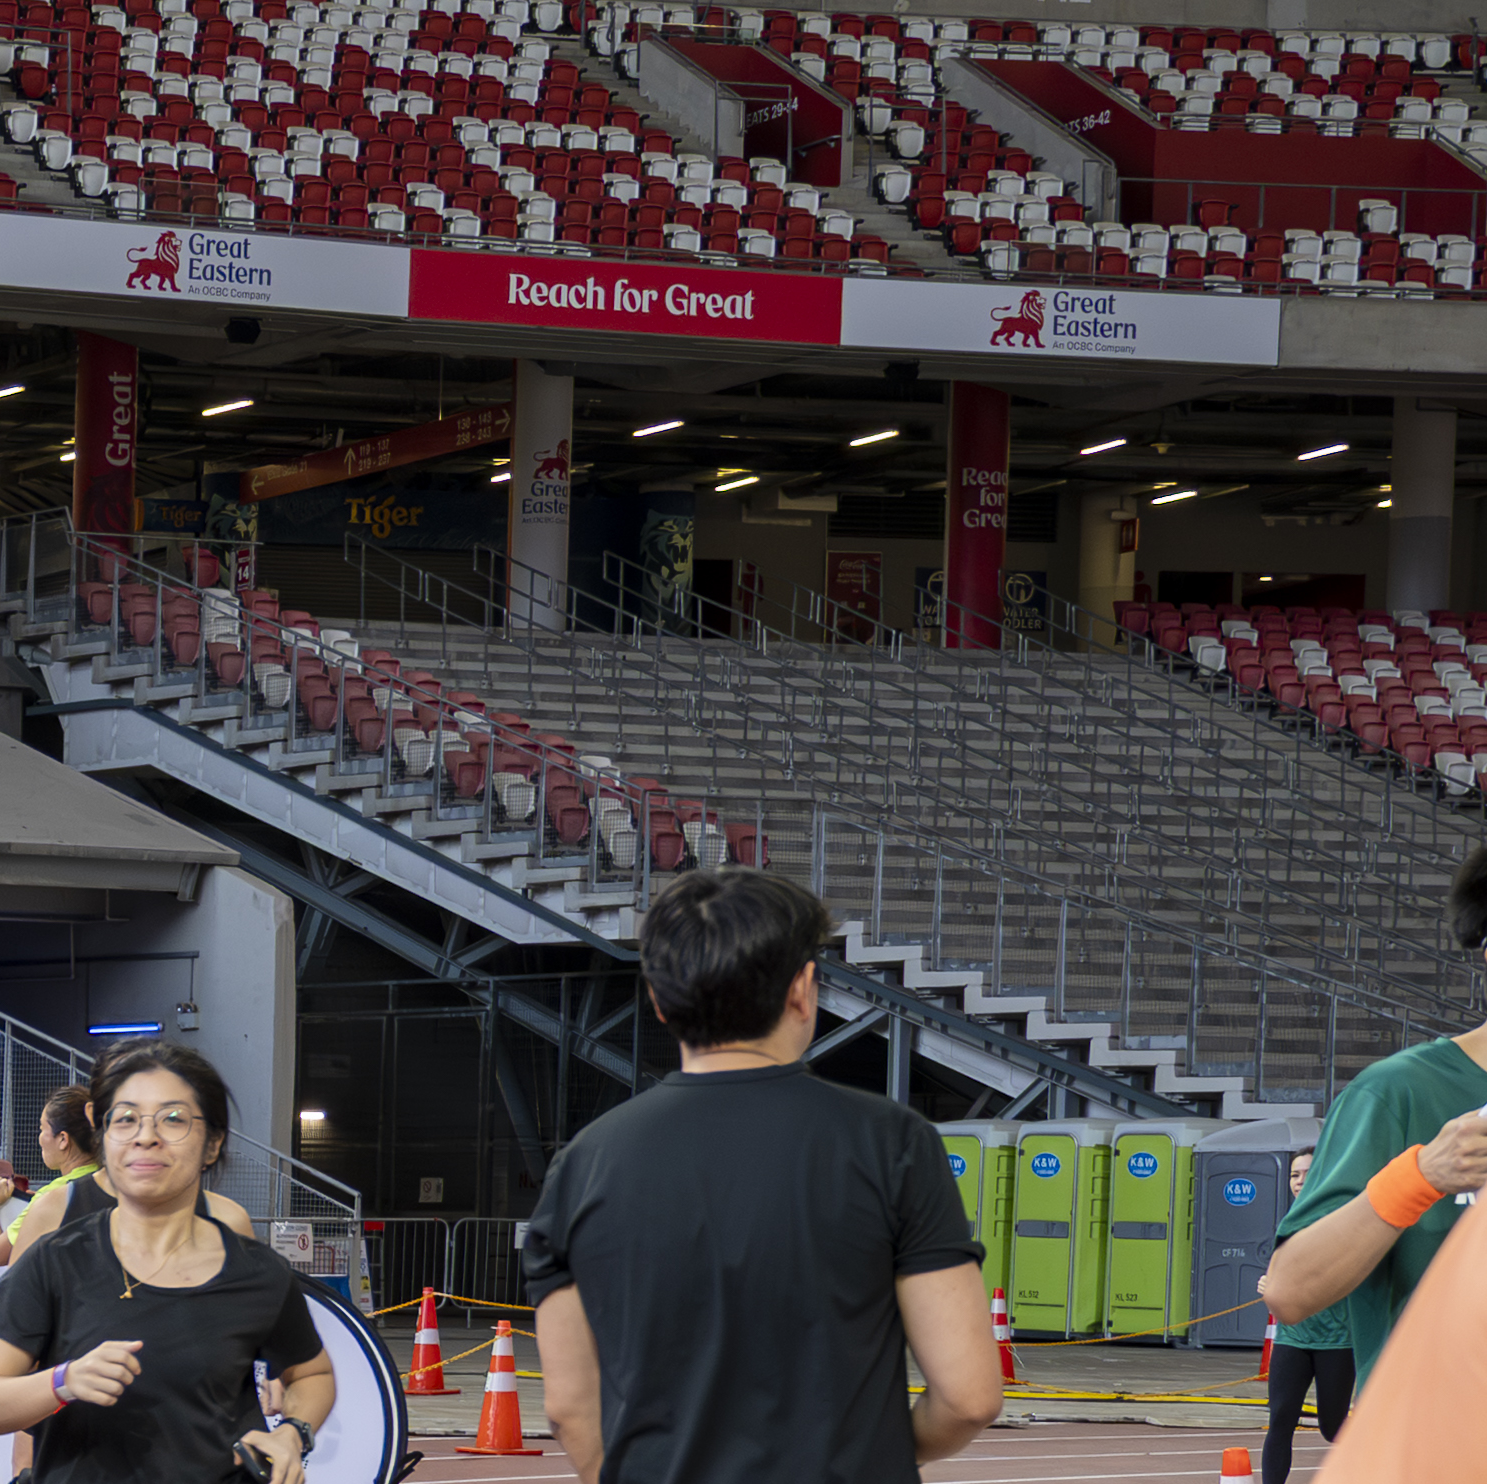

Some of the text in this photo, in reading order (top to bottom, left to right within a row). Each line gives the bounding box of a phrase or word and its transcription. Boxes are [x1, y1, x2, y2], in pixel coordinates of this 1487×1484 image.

[1082, 109, 1110, 131] 36-42
[188, 233, 251, 260] Great
[188, 257, 271, 286] Eastern
[188, 285, 271, 302] An OCBC Company
[508, 273, 755, 320] Reach for Great
[1053, 291, 1116, 315] Great
[1053, 314, 1136, 340] Eastern
[1052, 340, 1136, 355] An OCBC Company
[105, 371, 132, 467] Great
[979, 486, 1006, 507] for
[158, 504, 203, 528] Tiger
[344, 494, 424, 539] Tiger
[238, 565, 249, 582] 14
[1034, 1157, 1057, 1168] K&W
[1130, 1157, 1155, 1168] K&W
[1226, 1184, 1252, 1194] K&W
